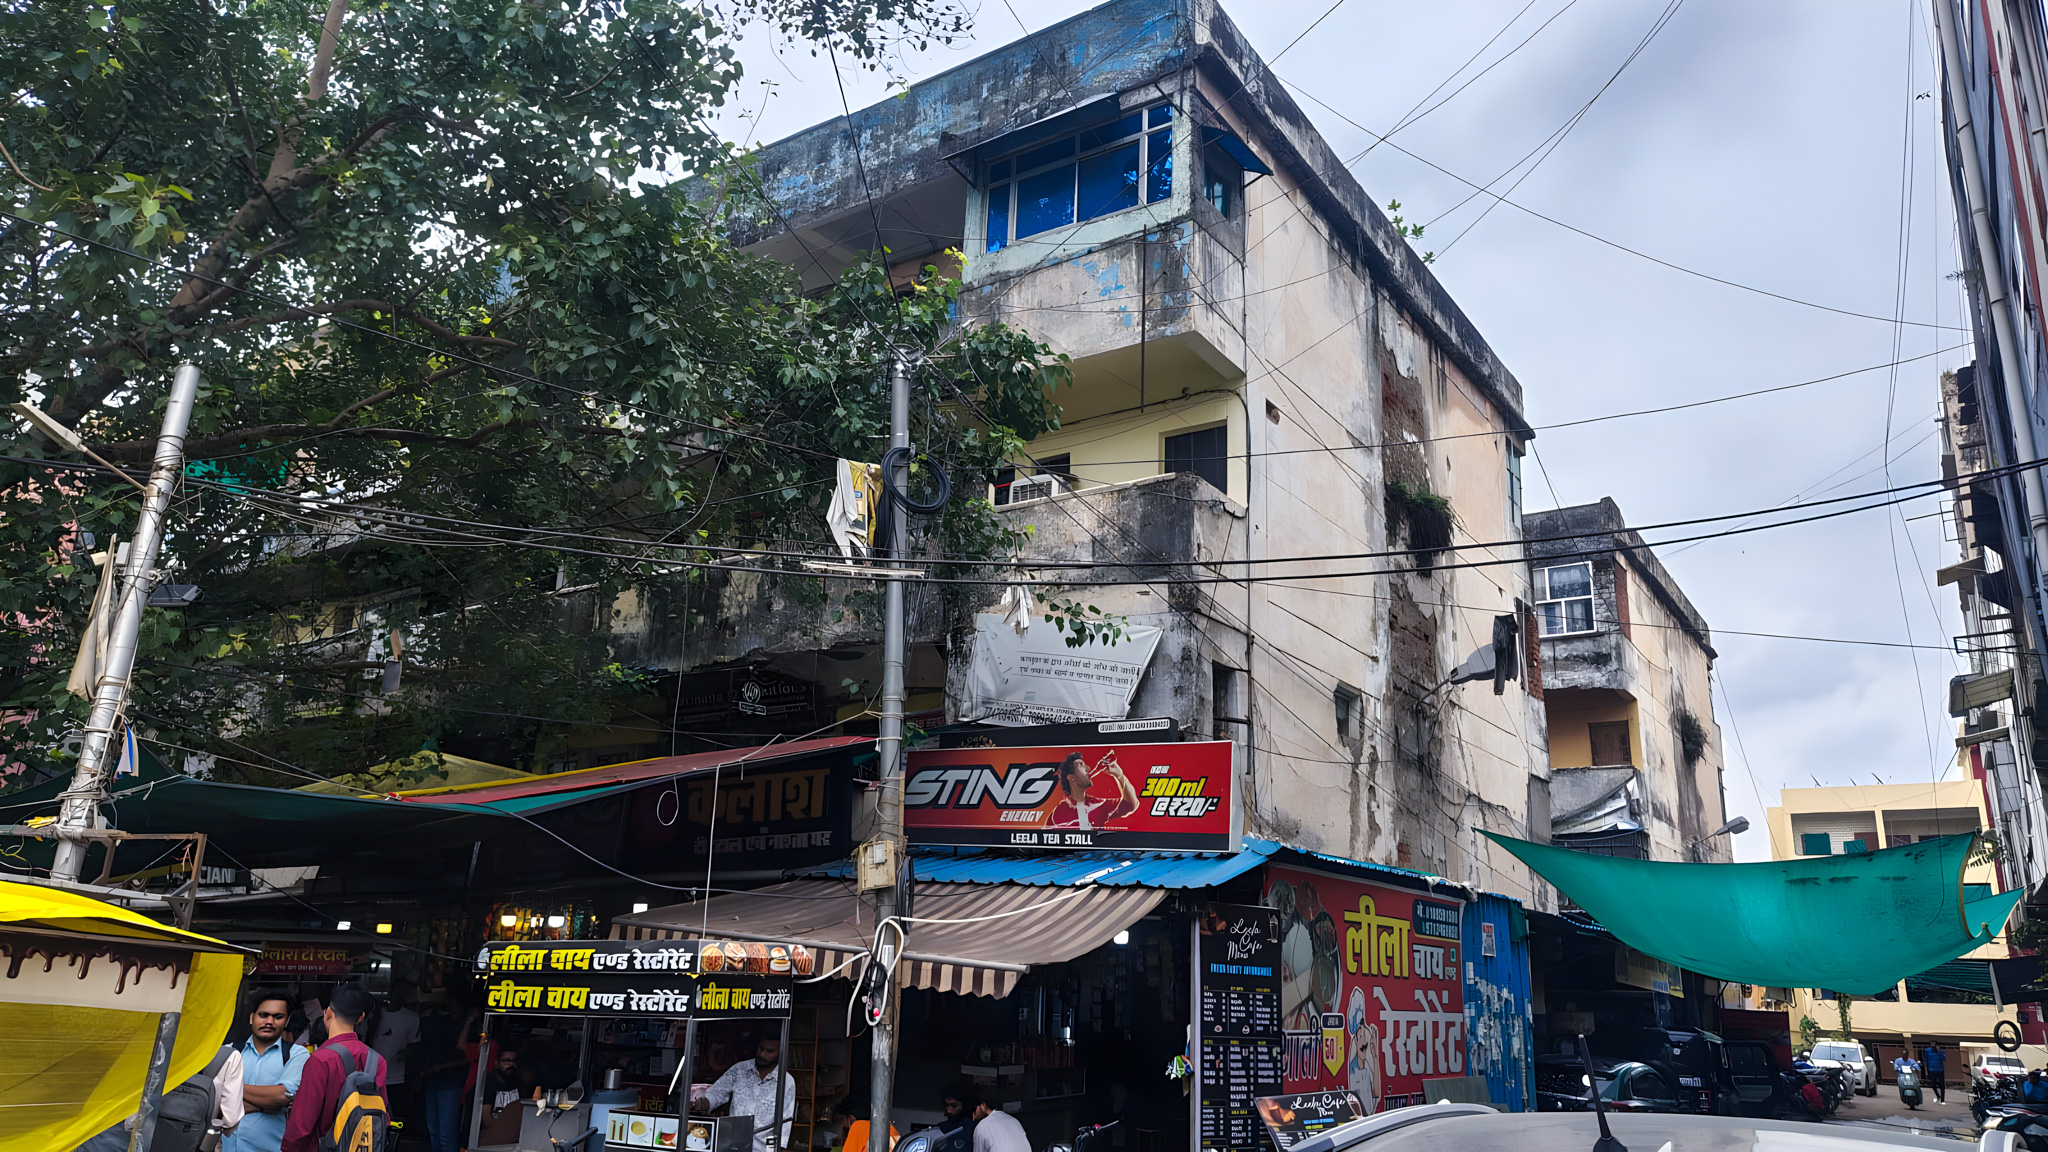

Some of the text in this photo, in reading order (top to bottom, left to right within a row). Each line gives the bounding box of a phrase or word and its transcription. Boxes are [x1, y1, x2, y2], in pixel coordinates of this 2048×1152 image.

[904, 768, 1056, 805] STING
[1141, 777, 1207, 797] 300ml
[999, 810, 1044, 823] ENERGY
[1011, 832, 1093, 845] LEELA TEA STALL
[1344, 894, 1411, 978] लीला
[490, 945, 694, 971] लीला चाय एण्ड रेस्टोरेंट
[1412, 943, 1445, 980] चाय
[487, 980, 690, 1012] लीला चाय एण्ड रेस्टोरेंट
[701, 982, 730, 1010] लीला
[731, 988, 752, 1010] चाय
[1373, 986, 1464, 1078] रेस्टोरेंट
